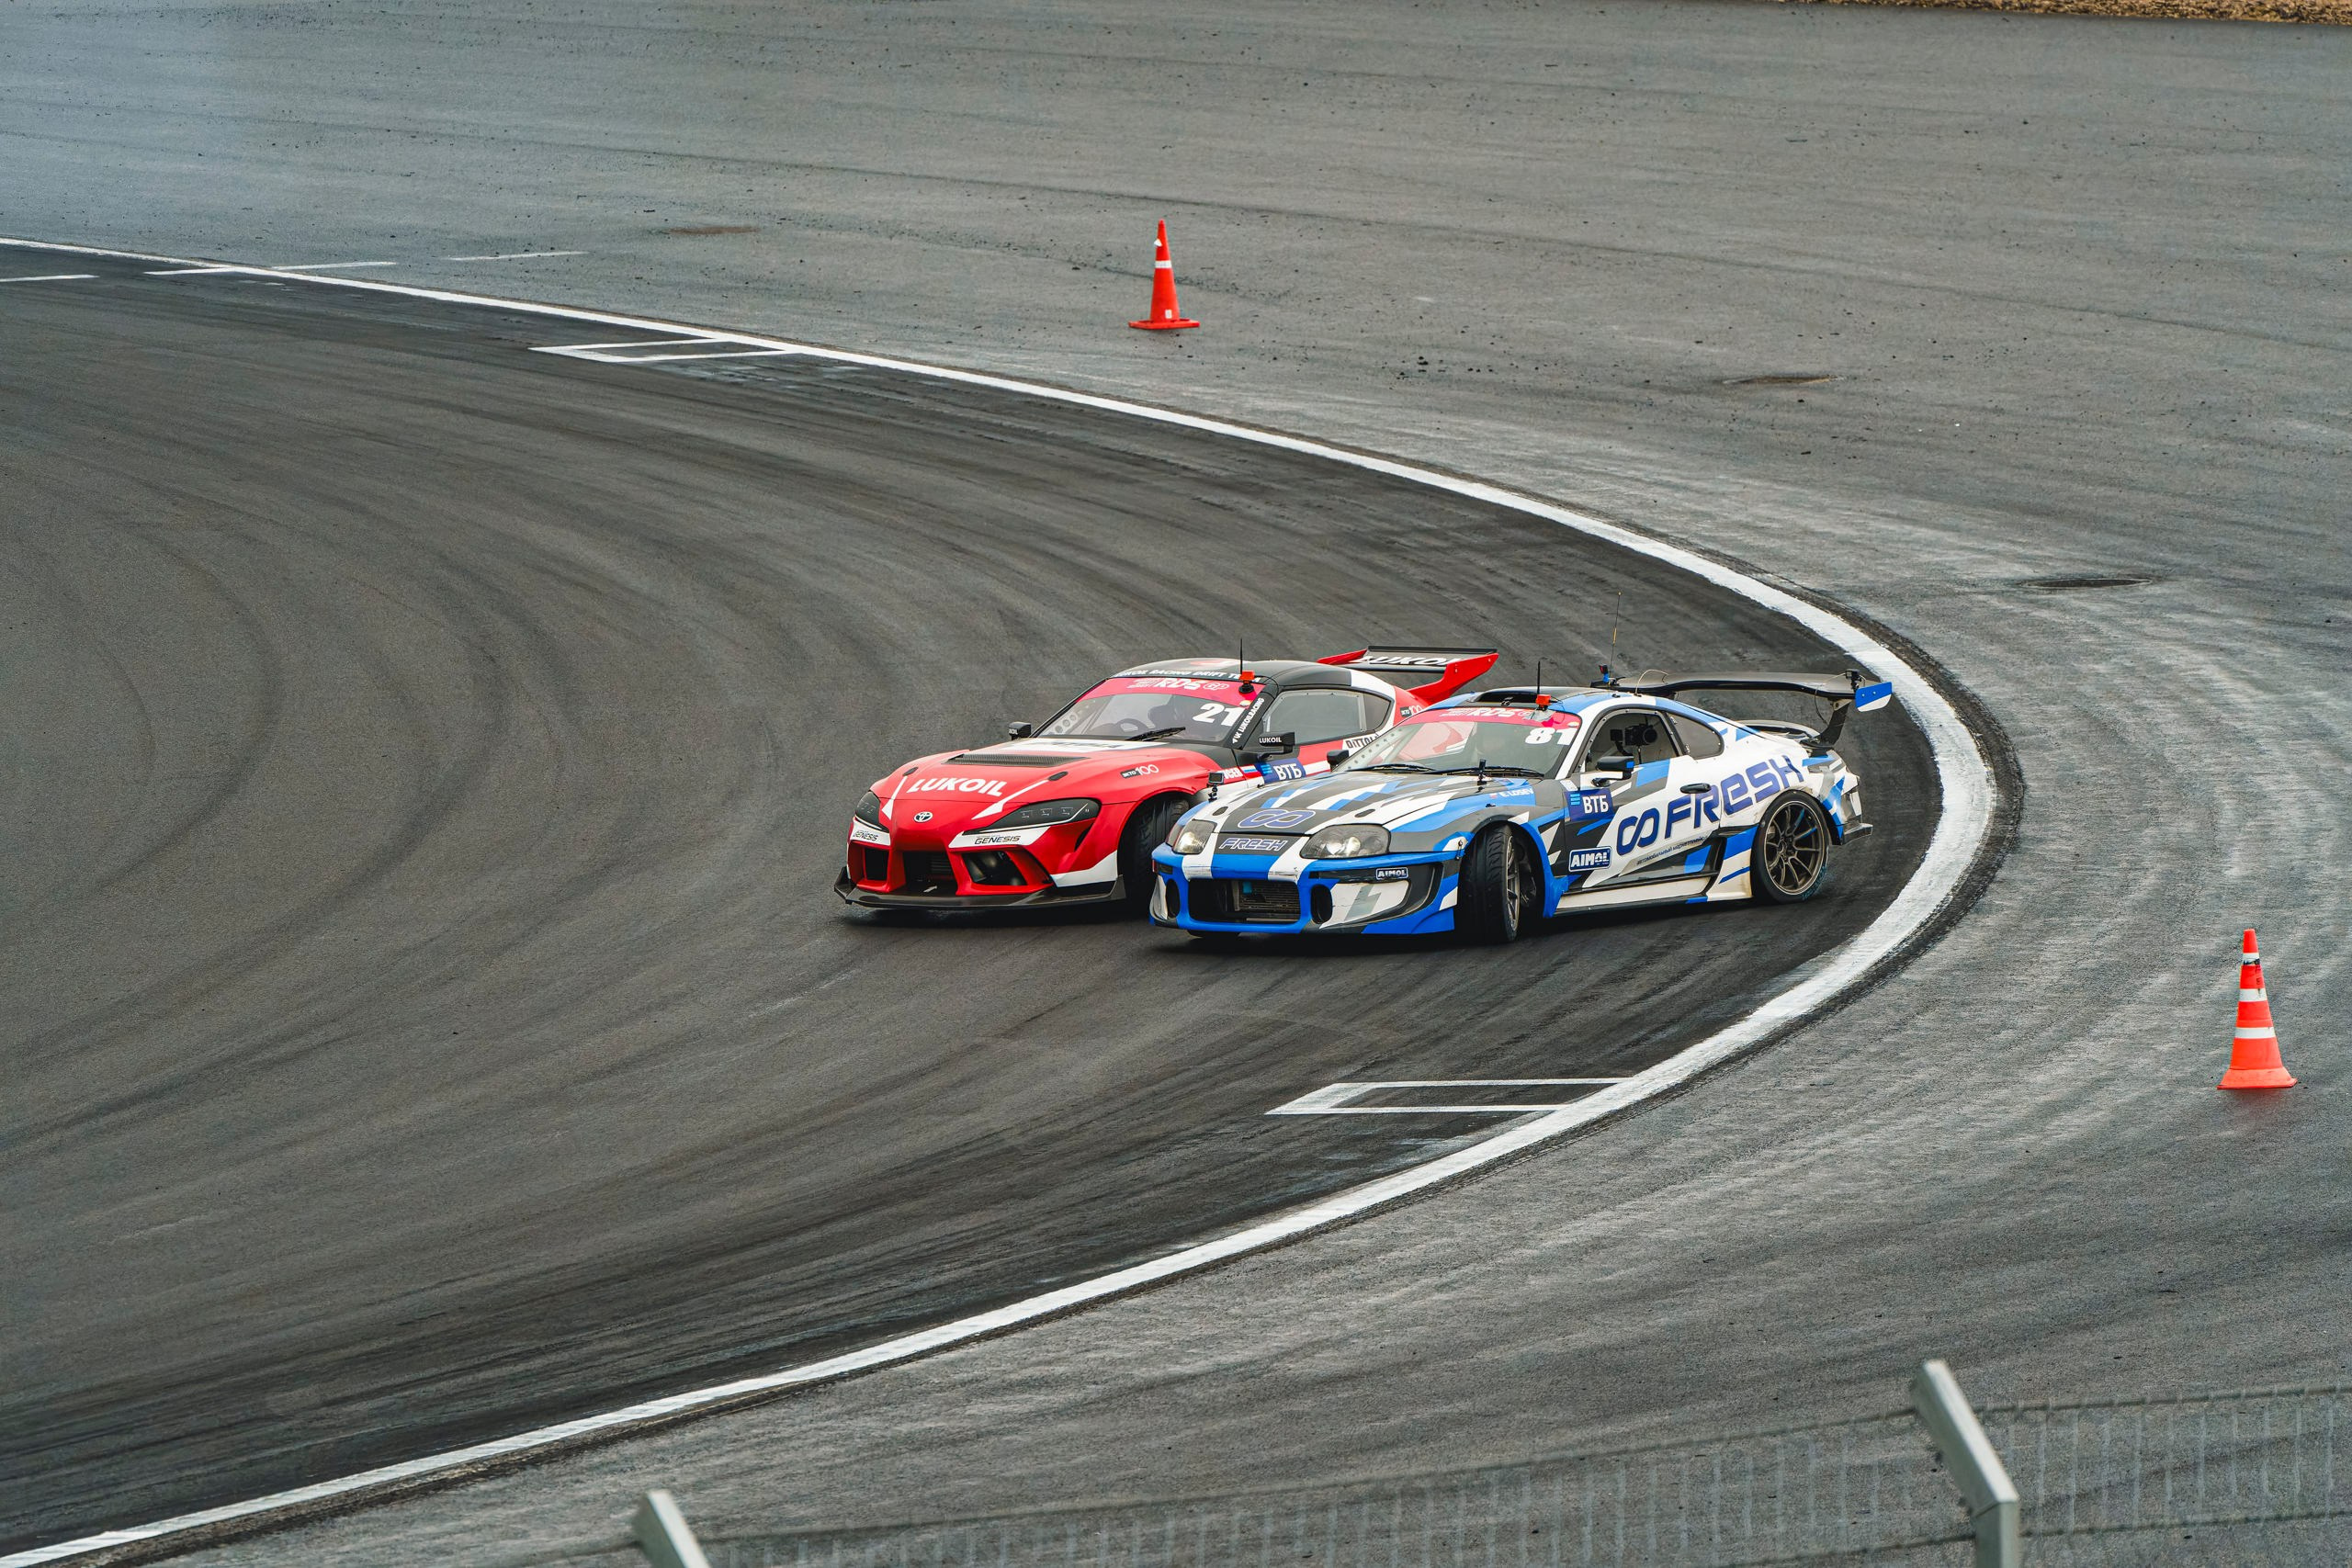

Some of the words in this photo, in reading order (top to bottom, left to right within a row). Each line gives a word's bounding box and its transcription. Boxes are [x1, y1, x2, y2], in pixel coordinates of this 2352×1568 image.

[1193, 703, 1246, 727] 21
[1525, 727, 1578, 745] 81
[1273, 763, 1302, 780] ВТБ
[906, 777, 1008, 797] LUKOIL
[1582, 795, 1609, 814] ВТБ
[854, 830, 879, 841] GENESIS
[974, 835, 1021, 845] GENESIS
[1570, 852, 1610, 868] AIMOL
[1378, 869, 1407, 878] AIMOL
